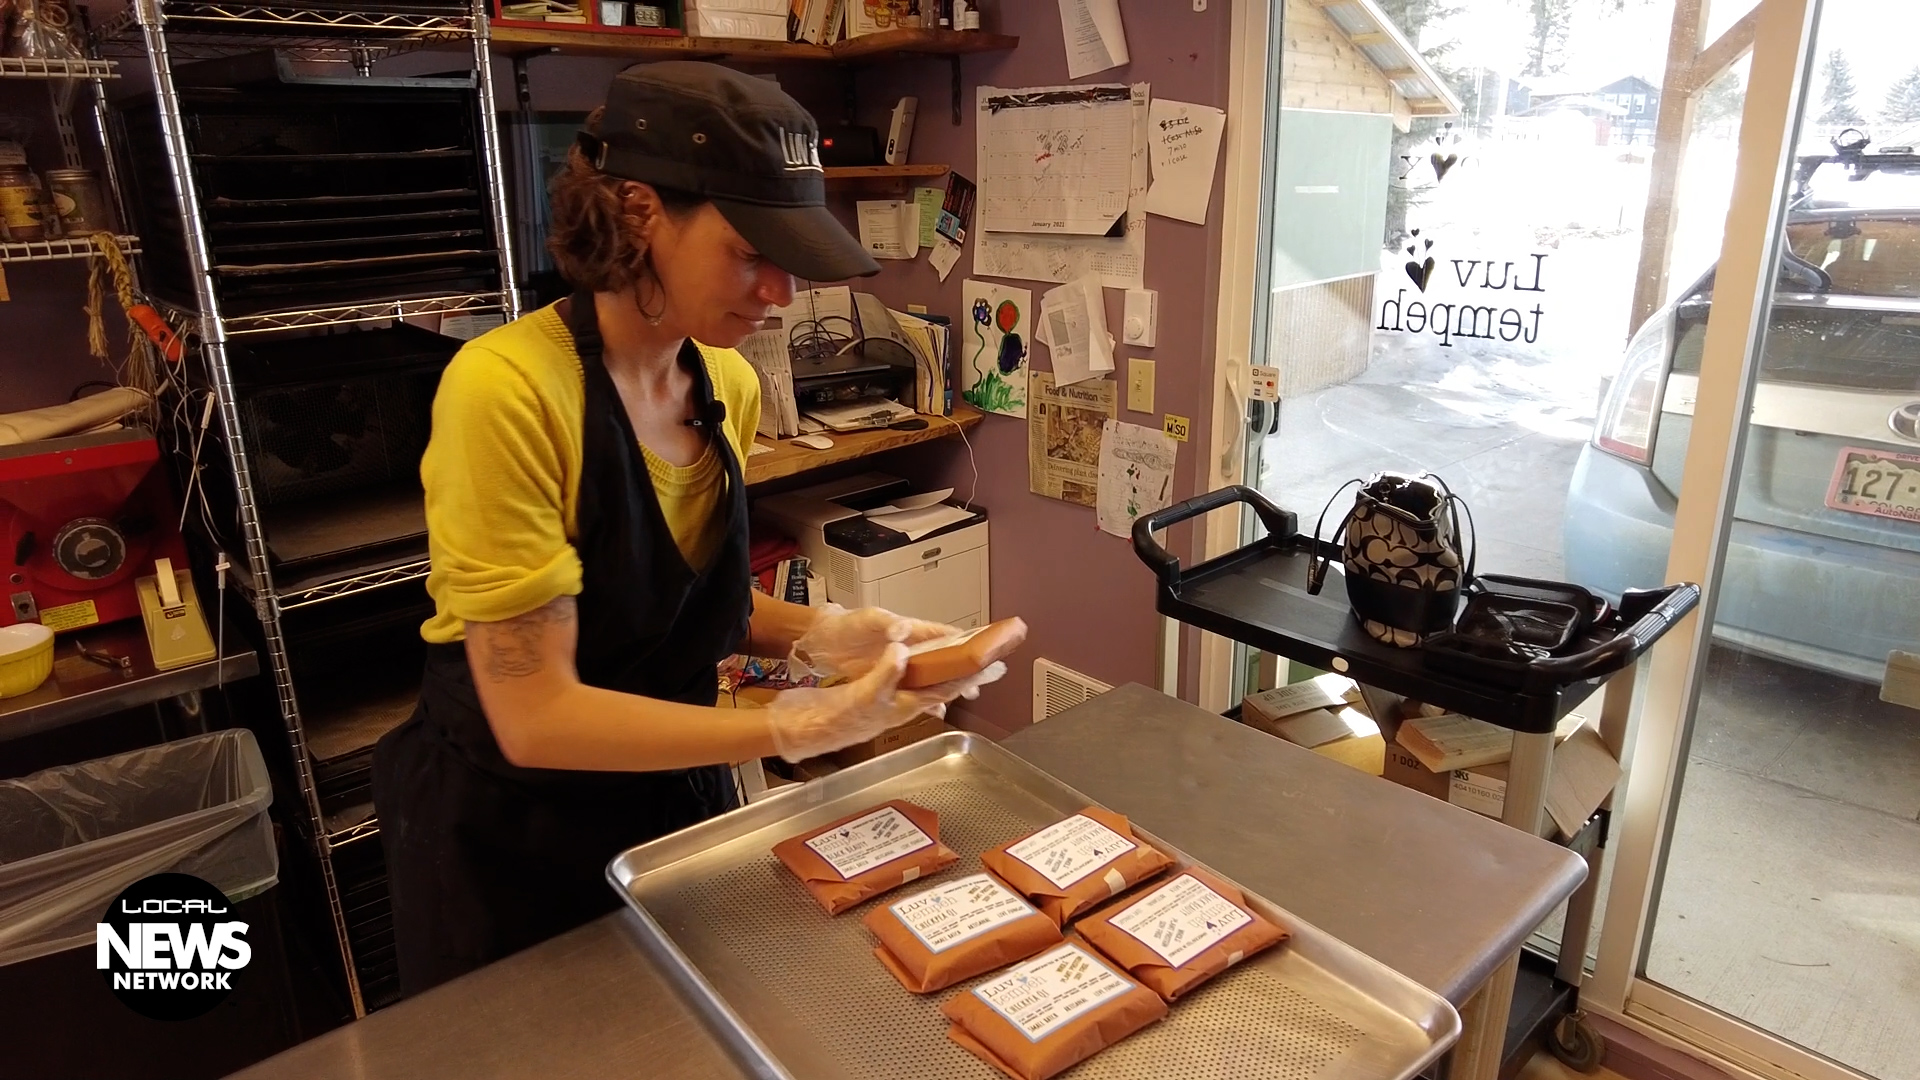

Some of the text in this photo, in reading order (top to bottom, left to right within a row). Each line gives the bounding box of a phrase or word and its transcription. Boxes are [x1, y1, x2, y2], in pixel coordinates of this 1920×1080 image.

[1045, 384, 1099, 402] Food & Nutrition
[1392, 753, 1420, 770] 1 DOZ
[1454, 770, 1469, 781] SKS
[811, 832, 838, 848] Luv
[817, 831, 865, 853] tempeh
[1104, 839, 1130, 855] Luv
[898, 898, 928, 916] Luv
[905, 895, 958, 923] tempeh
[914, 912, 948, 932] CHICKPEA
[1219, 909, 1245, 928] Luv
[983, 978, 1014, 999] Luv
[992, 974, 1049, 1007] tempeh
[1004, 994, 1039, 1016] CHICKPEA
